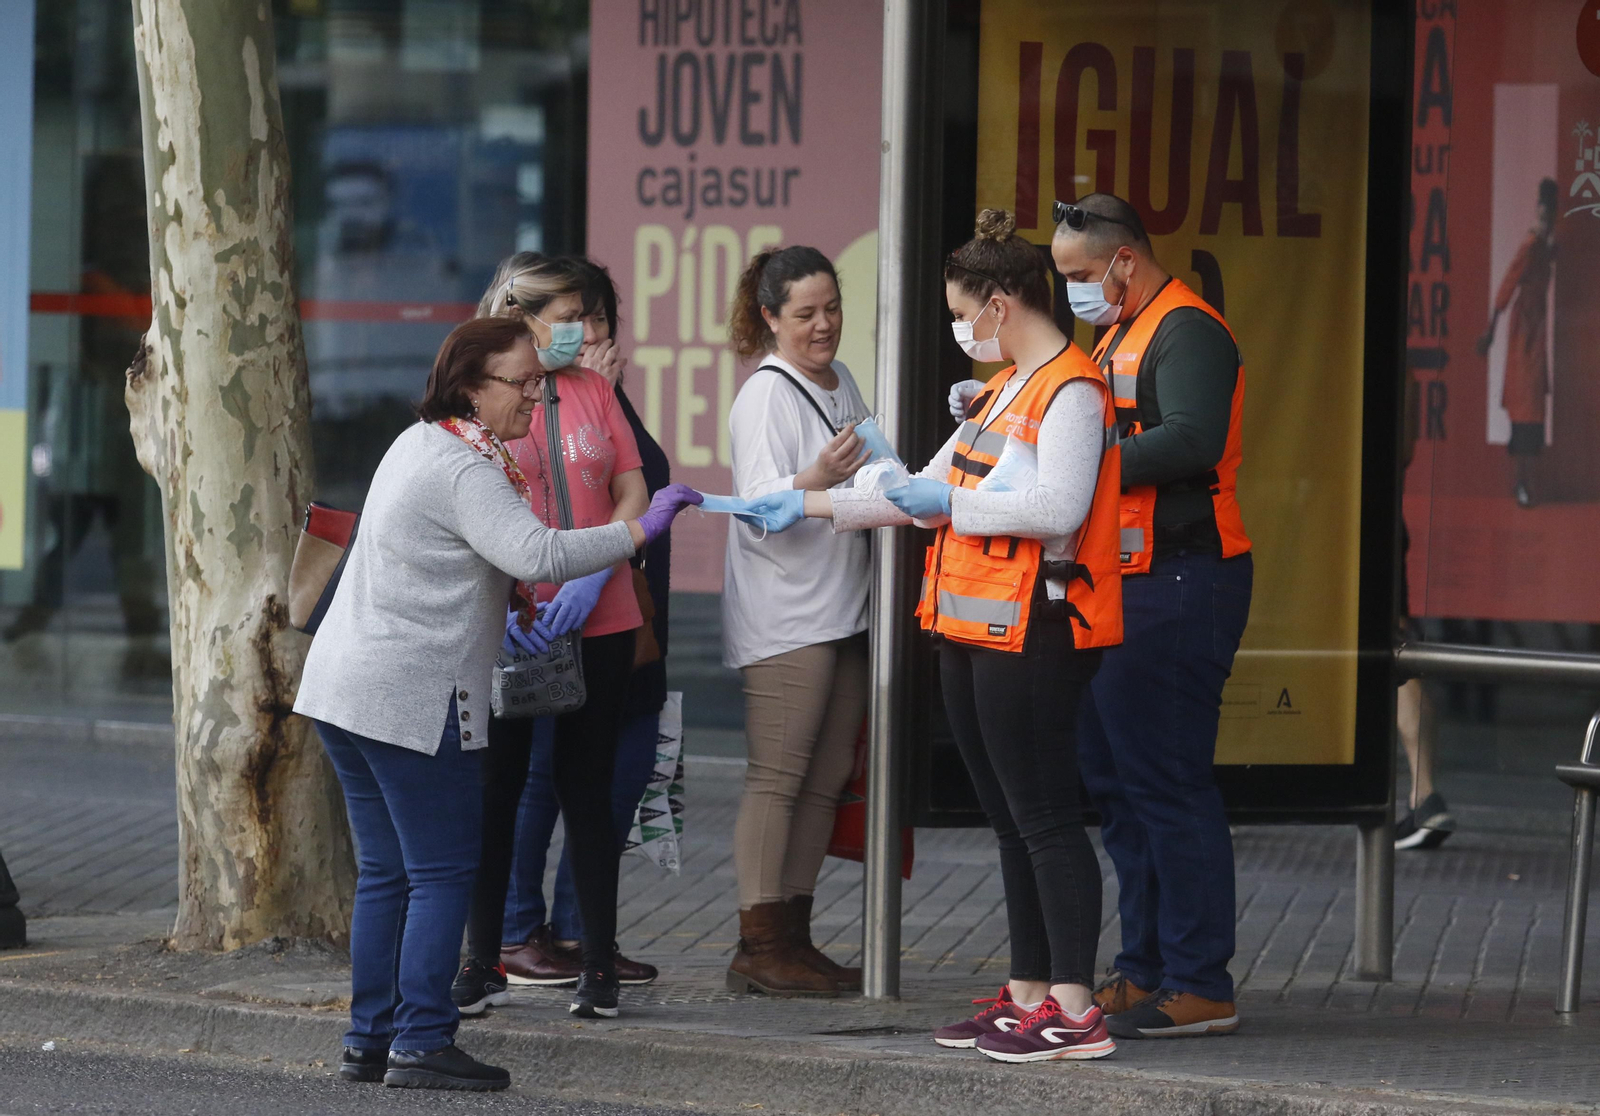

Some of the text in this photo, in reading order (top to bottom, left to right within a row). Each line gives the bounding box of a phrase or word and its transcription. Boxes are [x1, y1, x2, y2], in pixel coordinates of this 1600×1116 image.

[639, 0, 803, 46] HIPOTECA
[637, 52, 803, 147] JOVEN
[1015, 41, 1322, 238] IGUAL
[636, 152, 801, 220] cajasur
[499, 665, 547, 690] B&R
